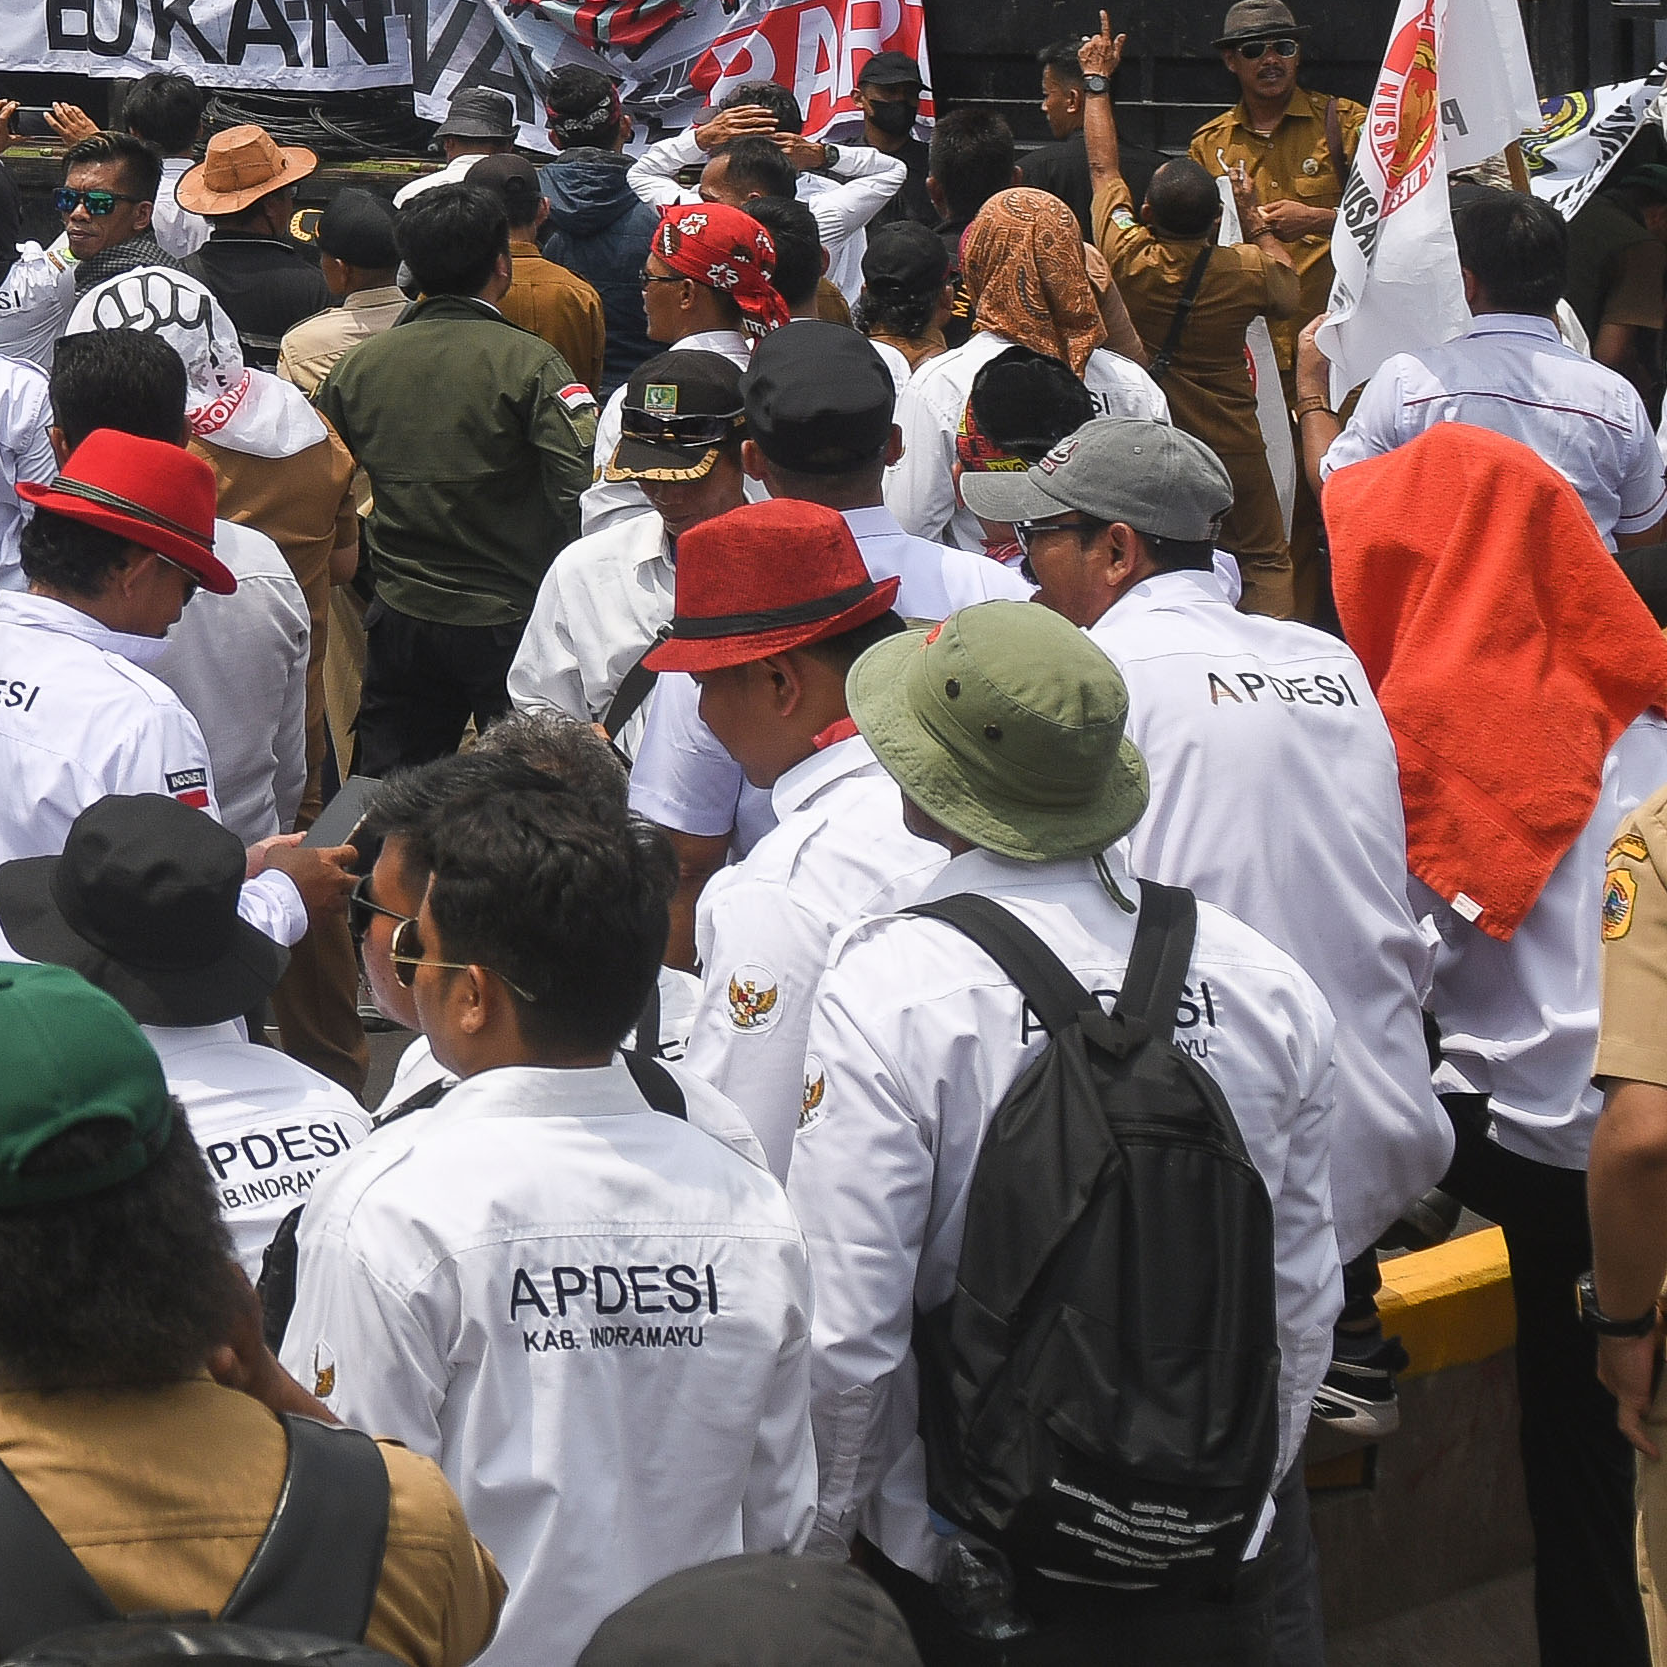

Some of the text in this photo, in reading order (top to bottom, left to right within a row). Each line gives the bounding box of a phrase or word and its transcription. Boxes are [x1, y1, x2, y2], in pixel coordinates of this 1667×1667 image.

[1209, 672, 1358, 708] APDESI
[509, 1264, 719, 1322] APDESI
[523, 1324, 704, 1352] KAB. INDRAMAYU
